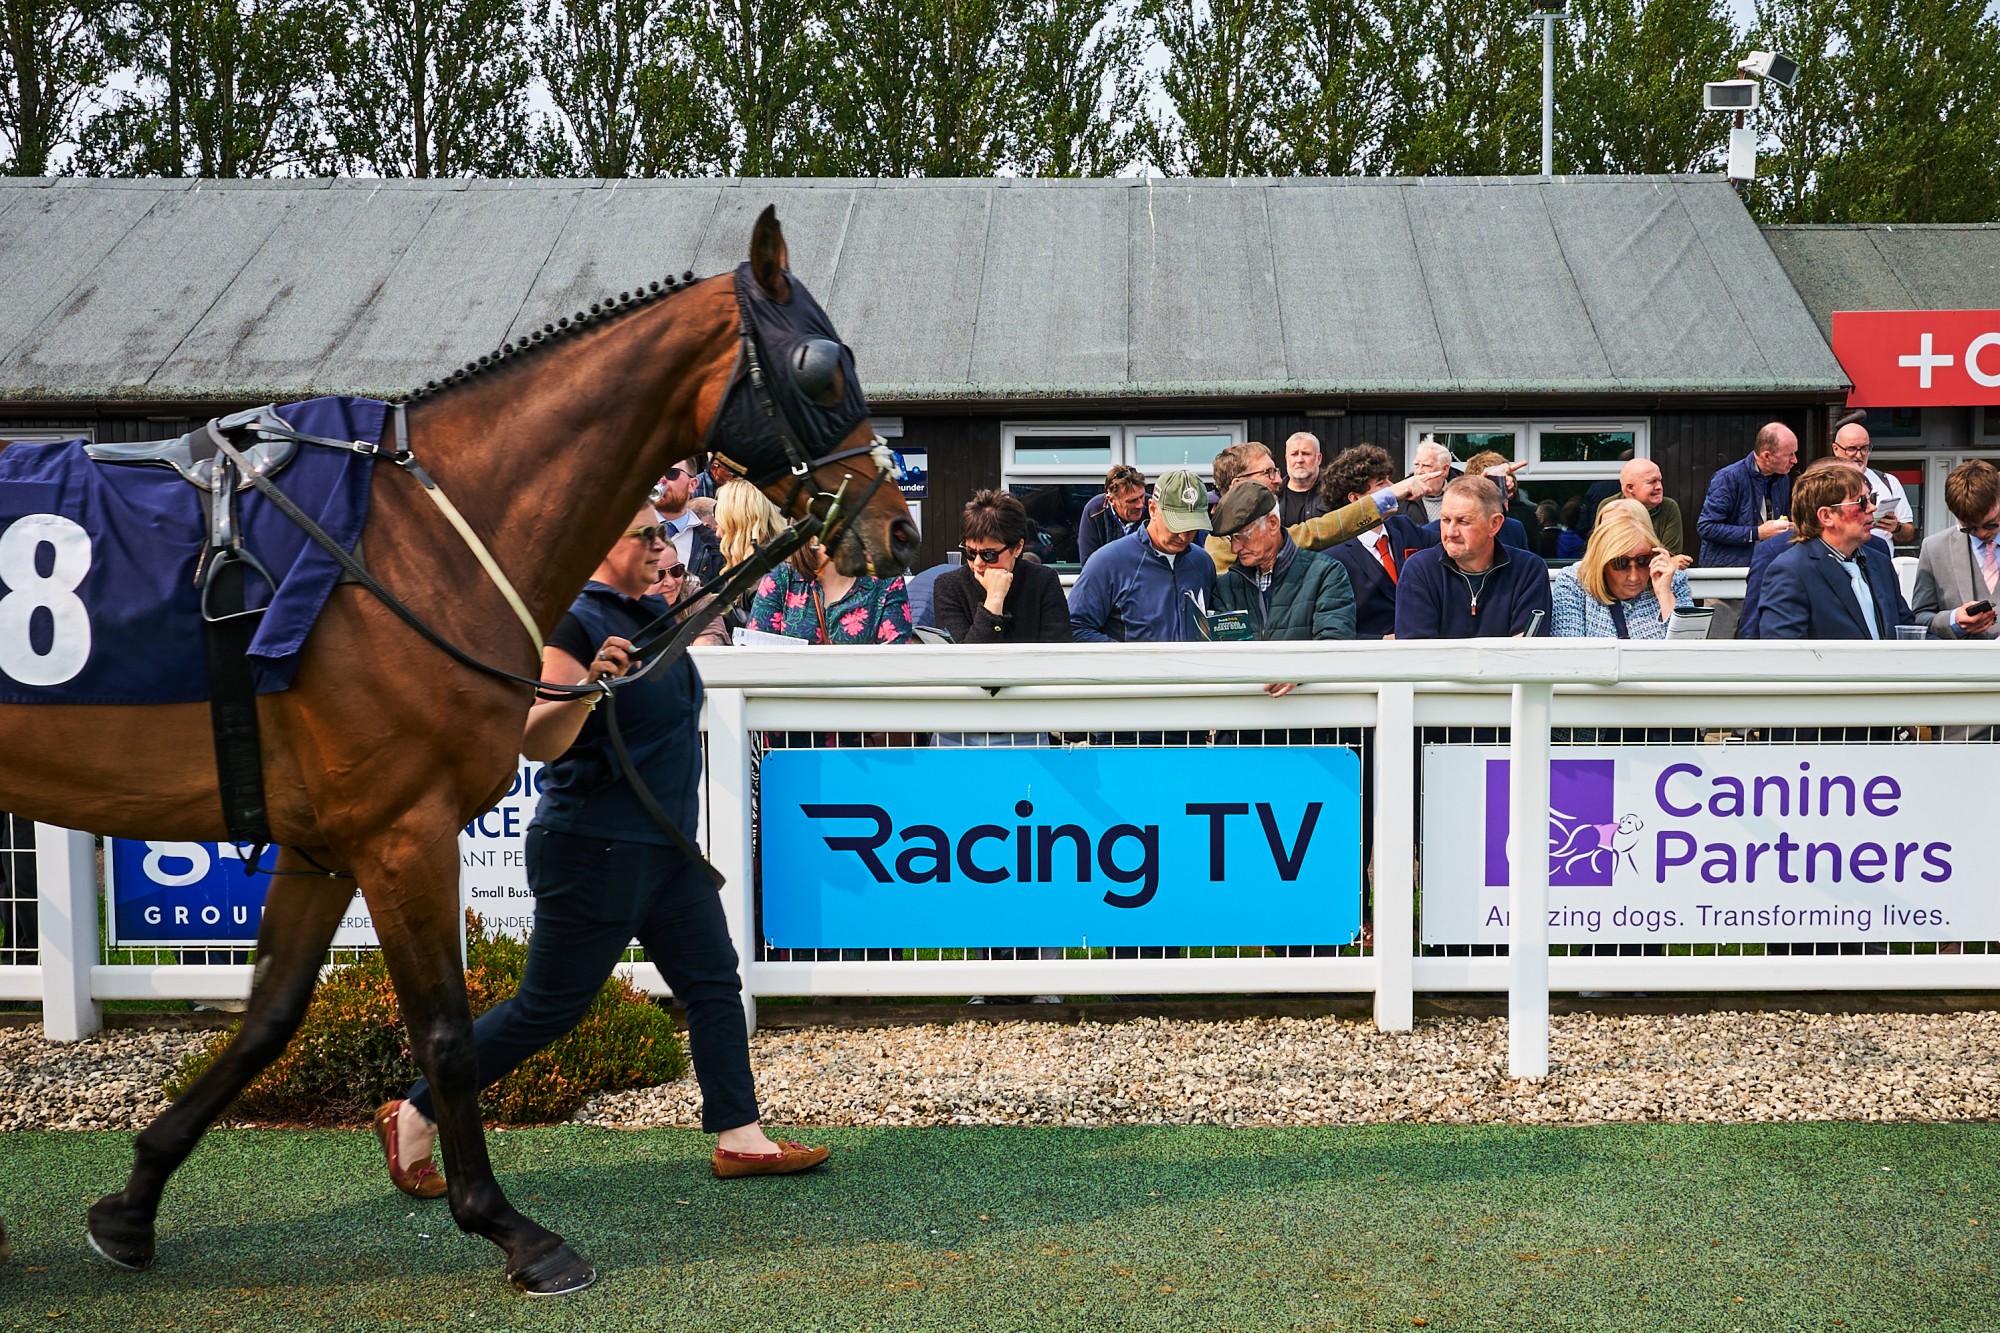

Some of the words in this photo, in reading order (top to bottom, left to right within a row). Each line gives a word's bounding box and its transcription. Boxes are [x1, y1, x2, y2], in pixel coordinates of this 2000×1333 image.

[0, 514, 92, 686] 8
[1655, 762, 1902, 817] Canine
[504, 851, 527, 867] PE
[799, 800, 1160, 908] Racing
[1186, 802, 1324, 881] TV
[1656, 830, 1952, 884] Partners
[472, 886, 503, 898] Small
[1486, 905, 1601, 932] Azing
[1613, 905, 1684, 932] dogs.
[1696, 905, 1872, 931] Transforming
[1884, 905, 1950, 926] lives.
